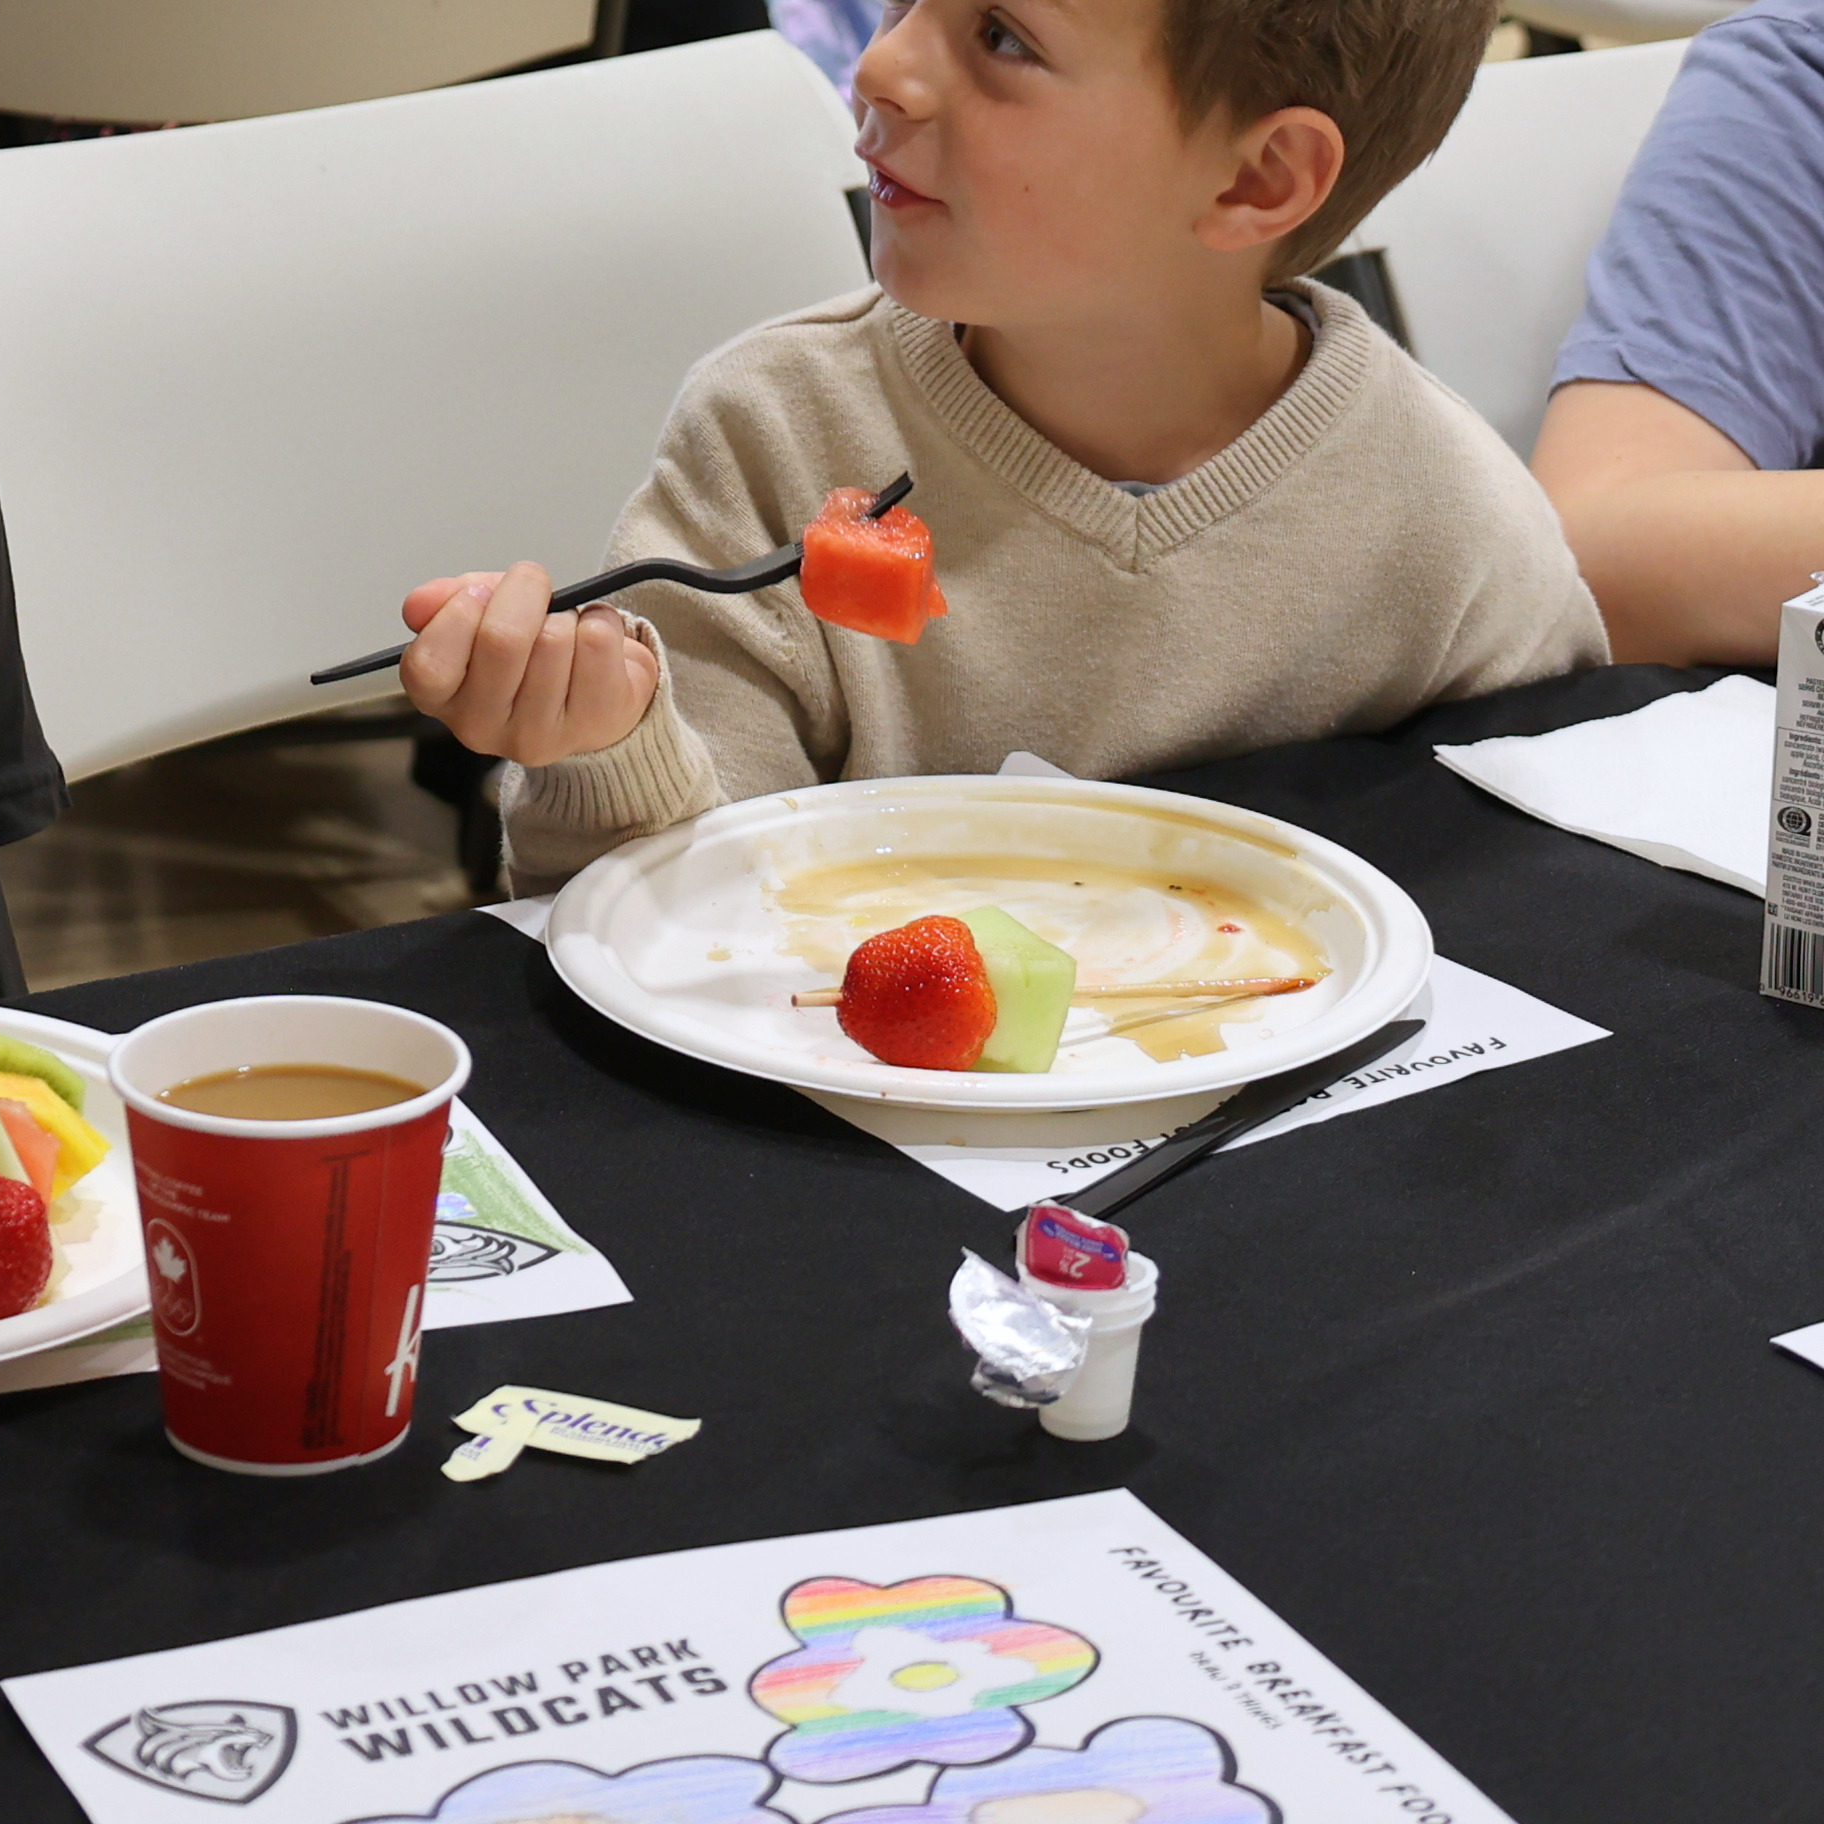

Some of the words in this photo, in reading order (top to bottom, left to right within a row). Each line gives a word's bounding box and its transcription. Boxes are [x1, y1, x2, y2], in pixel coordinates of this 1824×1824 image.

[1343, 1037, 1507, 1090] FAVOURITE
[1047, 1140, 1152, 1175] FOODS
[319, 1670, 540, 1730] WILLOW
[559, 1637, 703, 1685] PARK
[1108, 1544, 1253, 1651] FAVOURITE
[1245, 1660, 1397, 1776] BREAKFAST
[1189, 1650, 1227, 1682] DRAW
[1236, 1692, 1284, 1731] THINGS
[340, 1665, 729, 1762] WILDCATS
